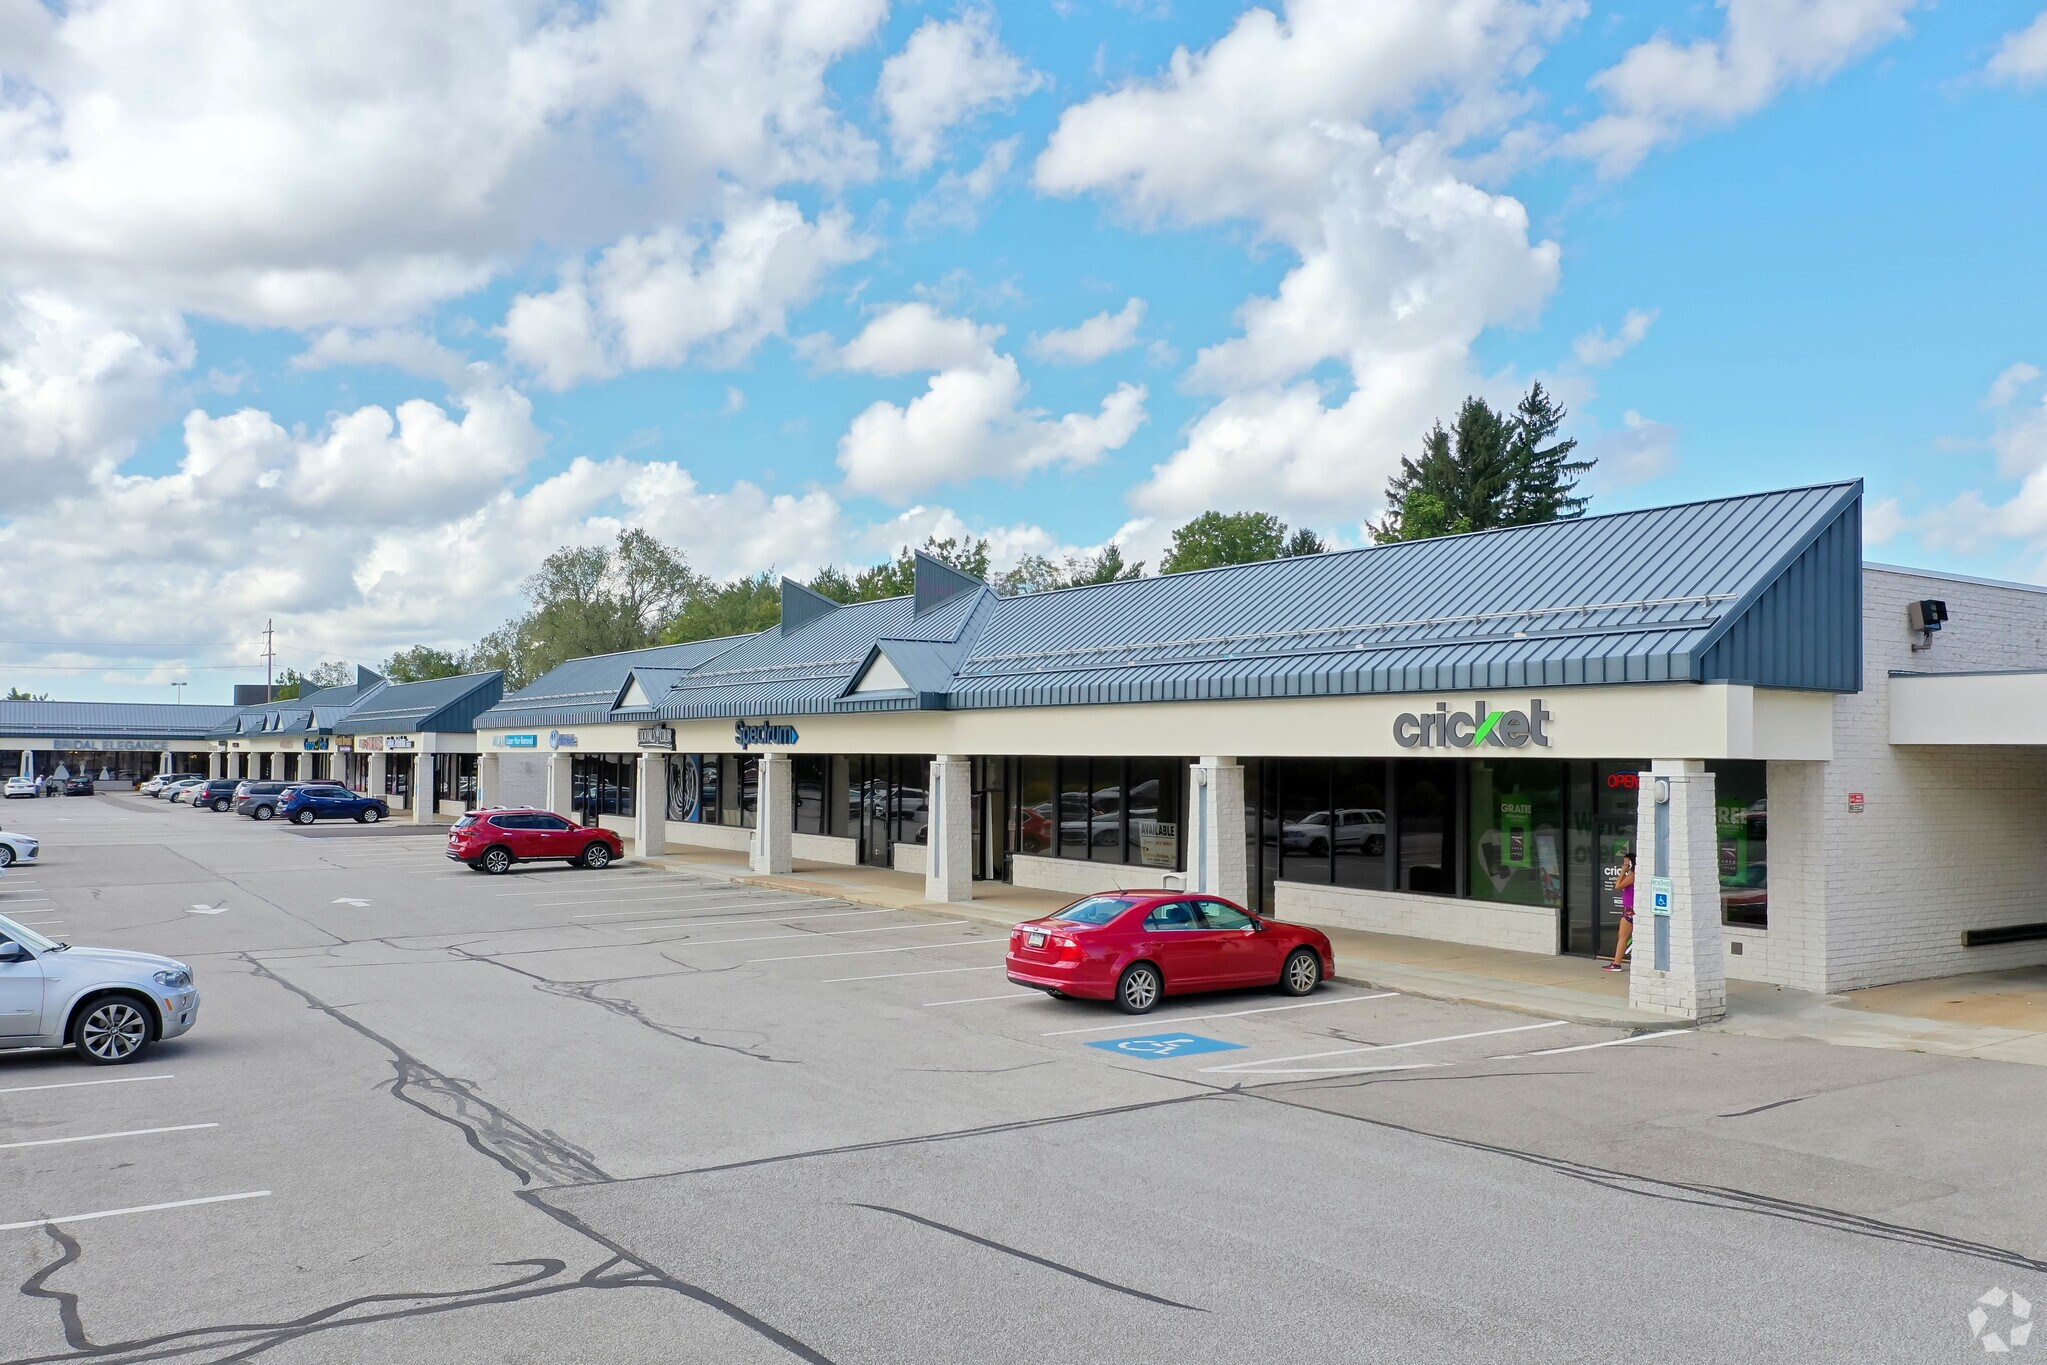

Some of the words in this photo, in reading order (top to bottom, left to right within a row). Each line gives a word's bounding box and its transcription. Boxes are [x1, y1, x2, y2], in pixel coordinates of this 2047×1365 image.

[1393, 699, 1553, 748] cricket
[735, 720, 793, 750] Spectrum
[53, 739, 98, 750] BRIDAL
[102, 740, 169, 751] ELEGANCE
[1608, 774, 1639, 789] OPEN
[1501, 803, 1532, 814] GRATIS
[1716, 806, 1748, 825] REE
[1141, 822, 1175, 837] AVAILABLE
